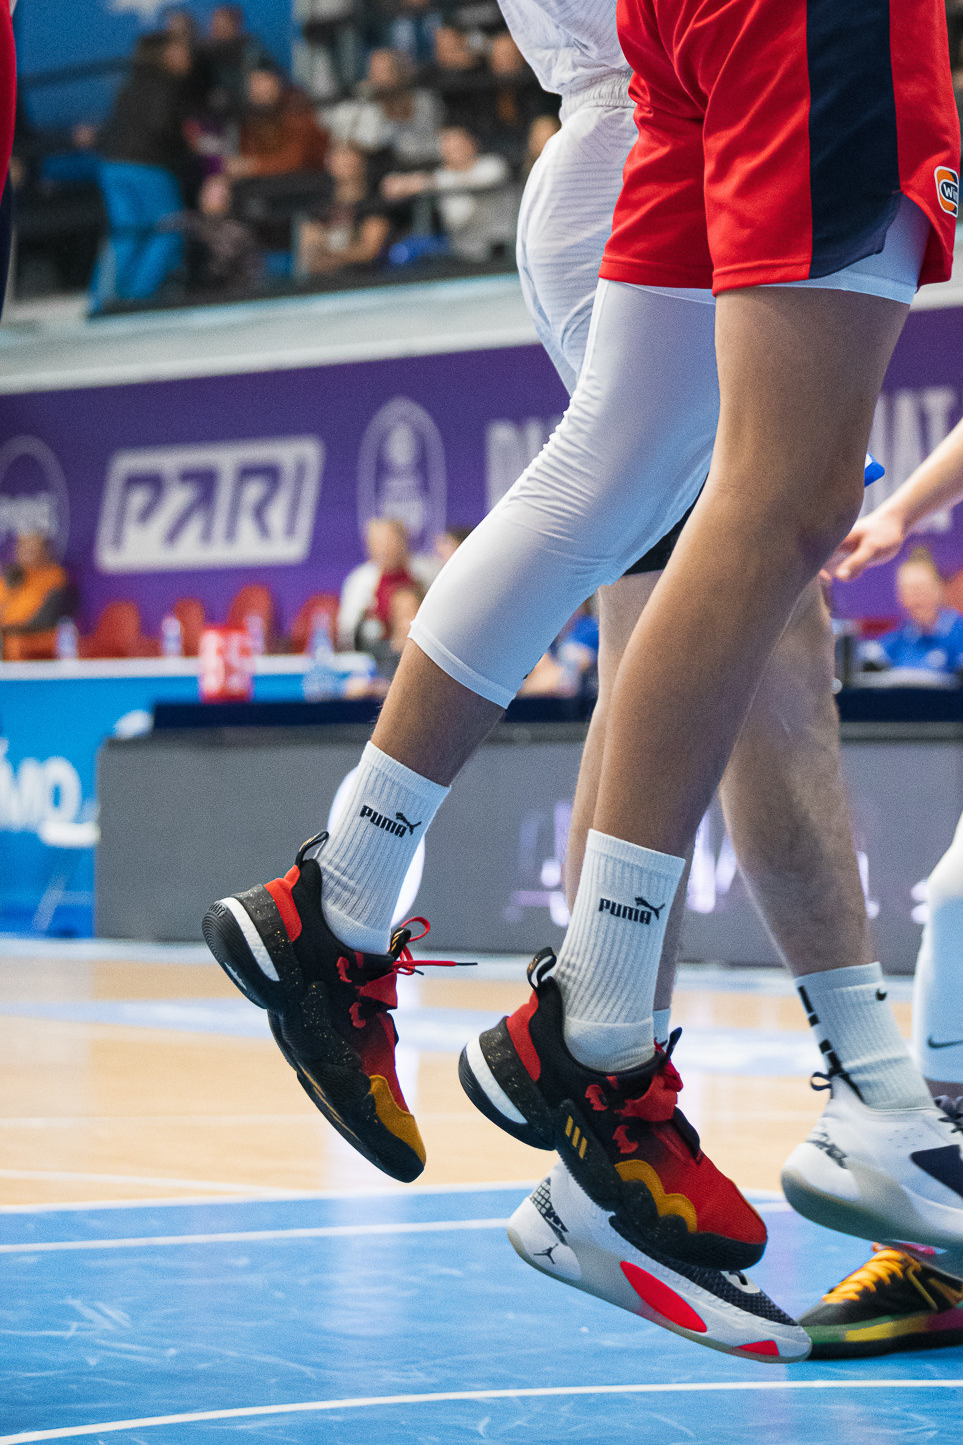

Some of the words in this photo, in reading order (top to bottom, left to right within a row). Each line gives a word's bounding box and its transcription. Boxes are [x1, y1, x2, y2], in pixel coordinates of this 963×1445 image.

[110, 454, 309, 553] PARI
[359, 804, 408, 839] PUMA
[597, 897, 653, 926] PUMA
